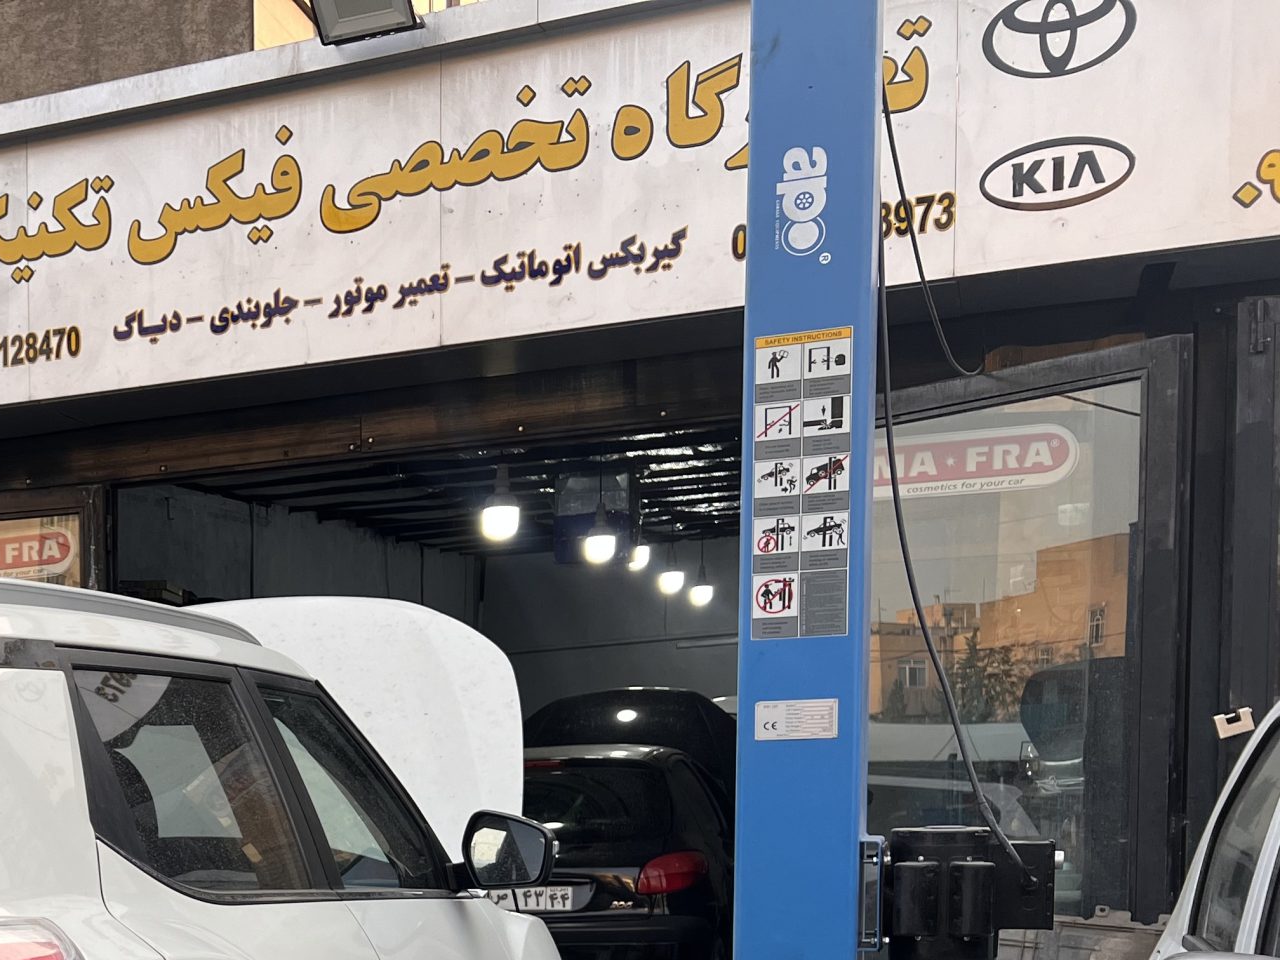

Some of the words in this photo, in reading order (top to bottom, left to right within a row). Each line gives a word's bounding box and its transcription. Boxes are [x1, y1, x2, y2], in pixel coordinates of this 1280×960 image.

[320, 75, 591, 234] تخصصی
[1012, 150, 1106, 198] KIA
[127, 124, 303, 266] فیکس
[480, 240, 582, 292] اتوماتیک
[587, 225, 689, 279] گیربکس
[328, 277, 387, 318] موتور
[393, 263, 451, 309] تعمیر
[209, 287, 300, 335] جلوبندی
[764, 336, 790, 346] SAFETY
[791, 330, 843, 343] INSTRUCTIONS
[906, 482, 958, 494] cosmetics
[960, 479, 978, 490] for
[979, 479, 1006, 491] your
[1007, 476, 1026, 487] car
